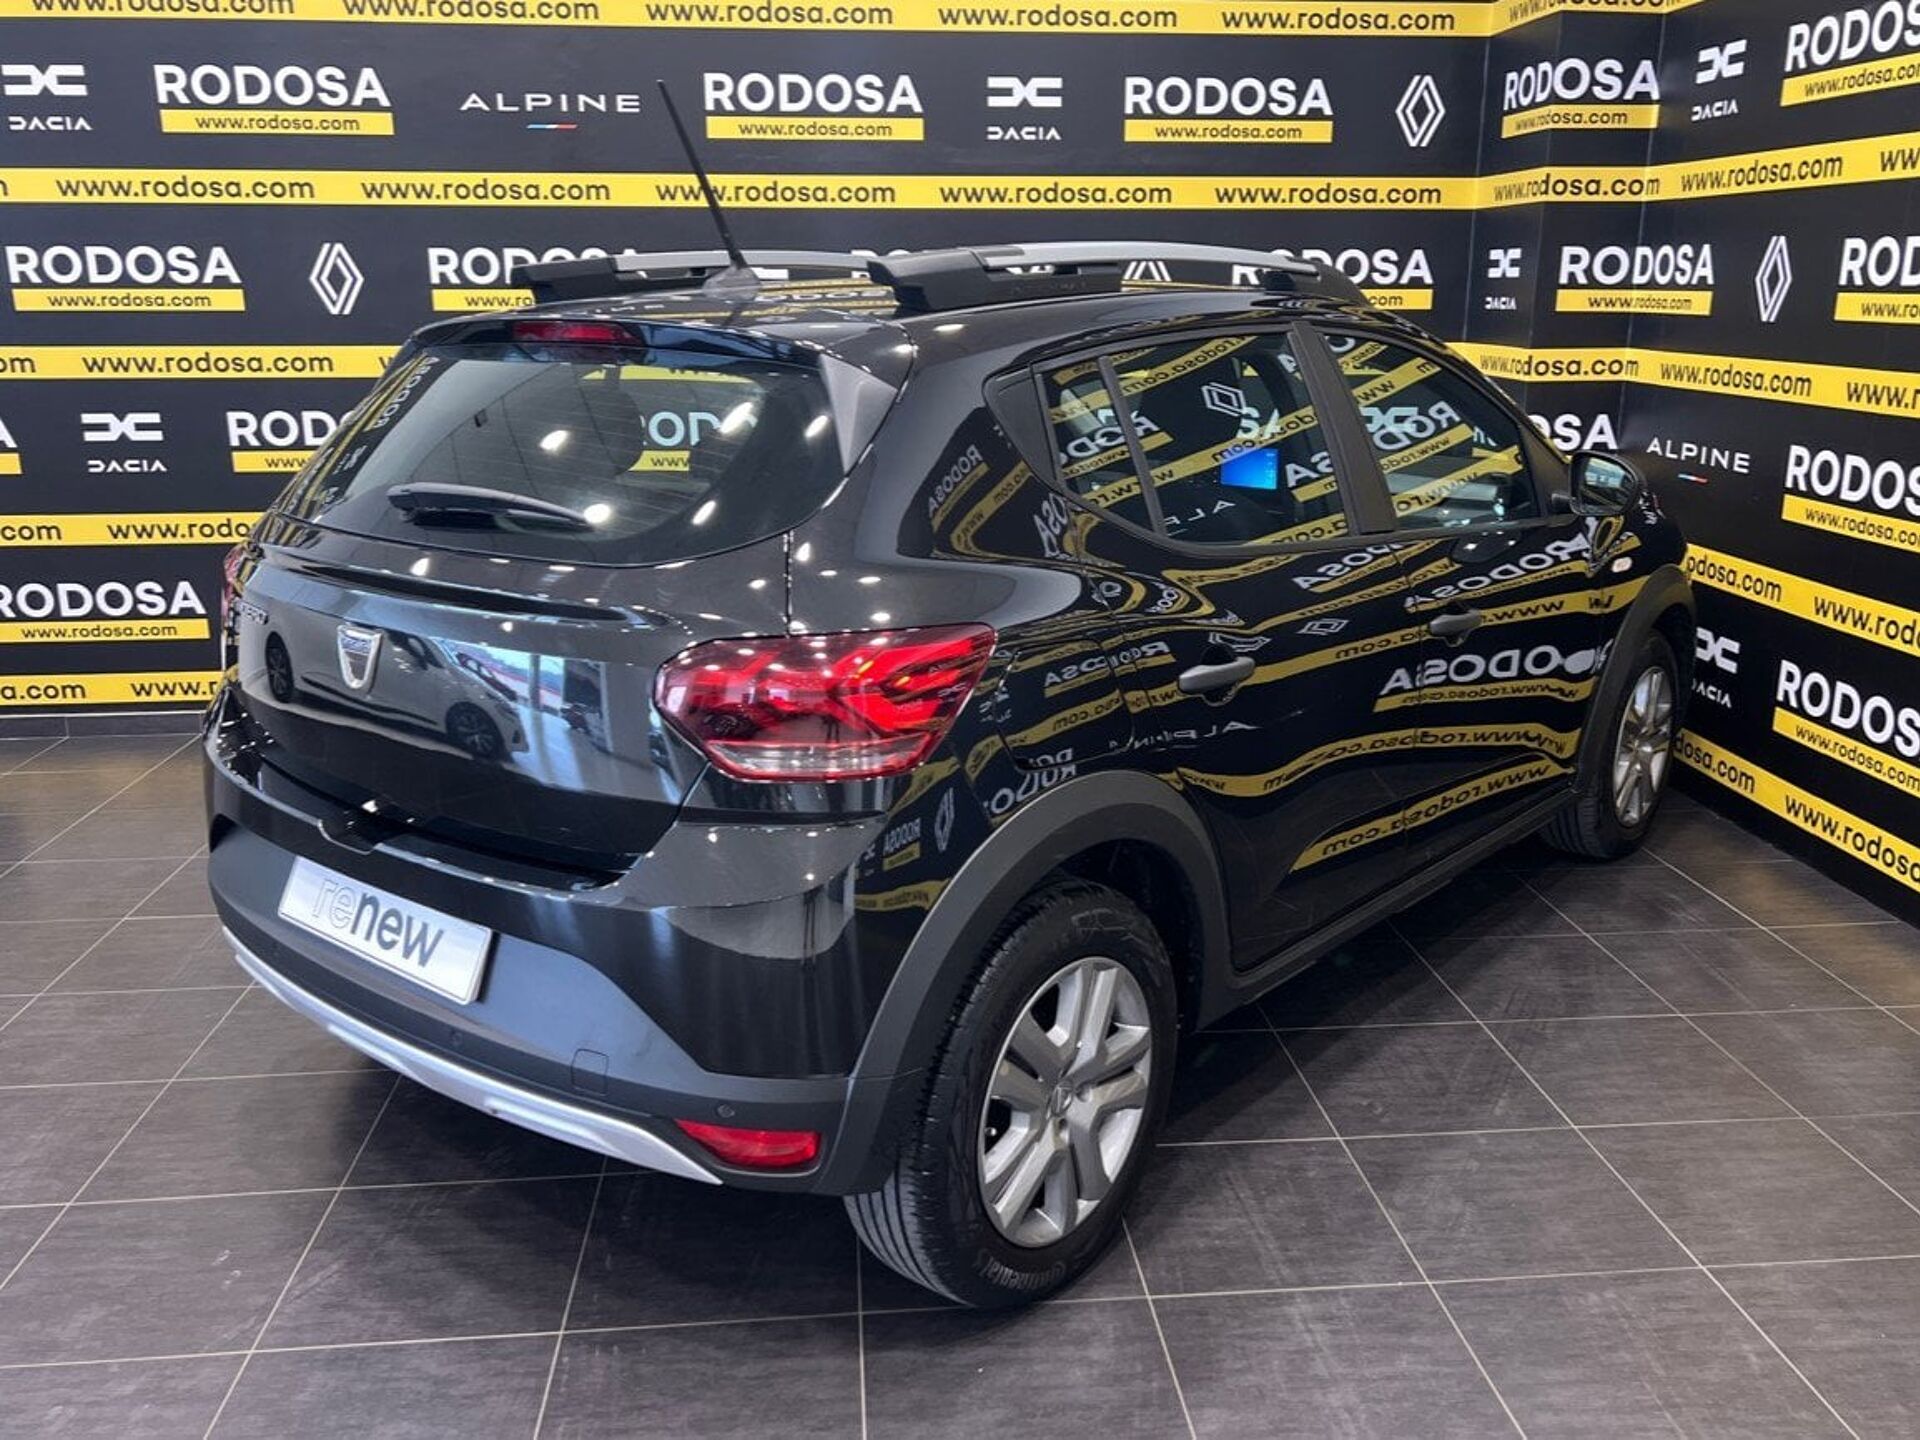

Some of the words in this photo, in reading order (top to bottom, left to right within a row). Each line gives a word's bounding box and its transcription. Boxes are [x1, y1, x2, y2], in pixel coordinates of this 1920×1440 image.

[344, 0, 600, 20] www.rodosa.com
[646, 1, 893, 24] www.rodosa.com
[938, 5, 1177, 27] www.rodosa.com
[1222, 8, 1455, 30] www.rodosa.com
[1784, 0, 1920, 72] RODOS
[154, 64, 392, 107] RODOSA
[1503, 57, 1661, 110] RODOSA
[1804, 62, 1920, 97] www.rodosa.co
[459, 93, 641, 113] ALPINE
[703, 72, 923, 113] RODOSA
[1124, 76, 1333, 116] RODOSA
[1691, 99, 1739, 121] DACIA
[9, 117, 92, 131] DACIA
[195, 114, 360, 131] www.rodosa.com
[738, 122, 892, 136] www.rodosa.com
[986, 127, 1061, 140] DACIA
[1155, 124, 1302, 139] www.rodosa.com
[1681, 156, 1843, 192] www.rodosa.com
[57, 176, 314, 198] www.rodosa.com
[361, 179, 610, 200] www.rodosa.com
[656, 181, 896, 202] www.rodosa.com
[940, 182, 1171, 203] www.rodosa.com
[1215, 183, 1441, 204] www.rodosa.com
[1493, 172, 1661, 201] www.rodosa.com
[5, 245, 242, 284] RODOSA
[1558, 243, 1715, 286] RODOSA
[48, 292, 212, 308] www.rodosa.com
[1588, 293, 1692, 311] www.rodosa.com
[82, 352, 334, 373] www.rodosa.com
[1480, 353, 1639, 377] www.rodosa.com
[1660, 361, 1812, 397] www.rodosa.com
[87, 459, 168, 473] DACIA
[1646, 437, 1751, 474] ALPINE
[1785, 444, 1920, 516] RODOS
[1805, 507, 1920, 545] www.rodosa.co
[21, 624, 178, 639] www.rodosa.com
[1776, 659, 1920, 758] RODOS
[312, 877, 444, 968] renew
